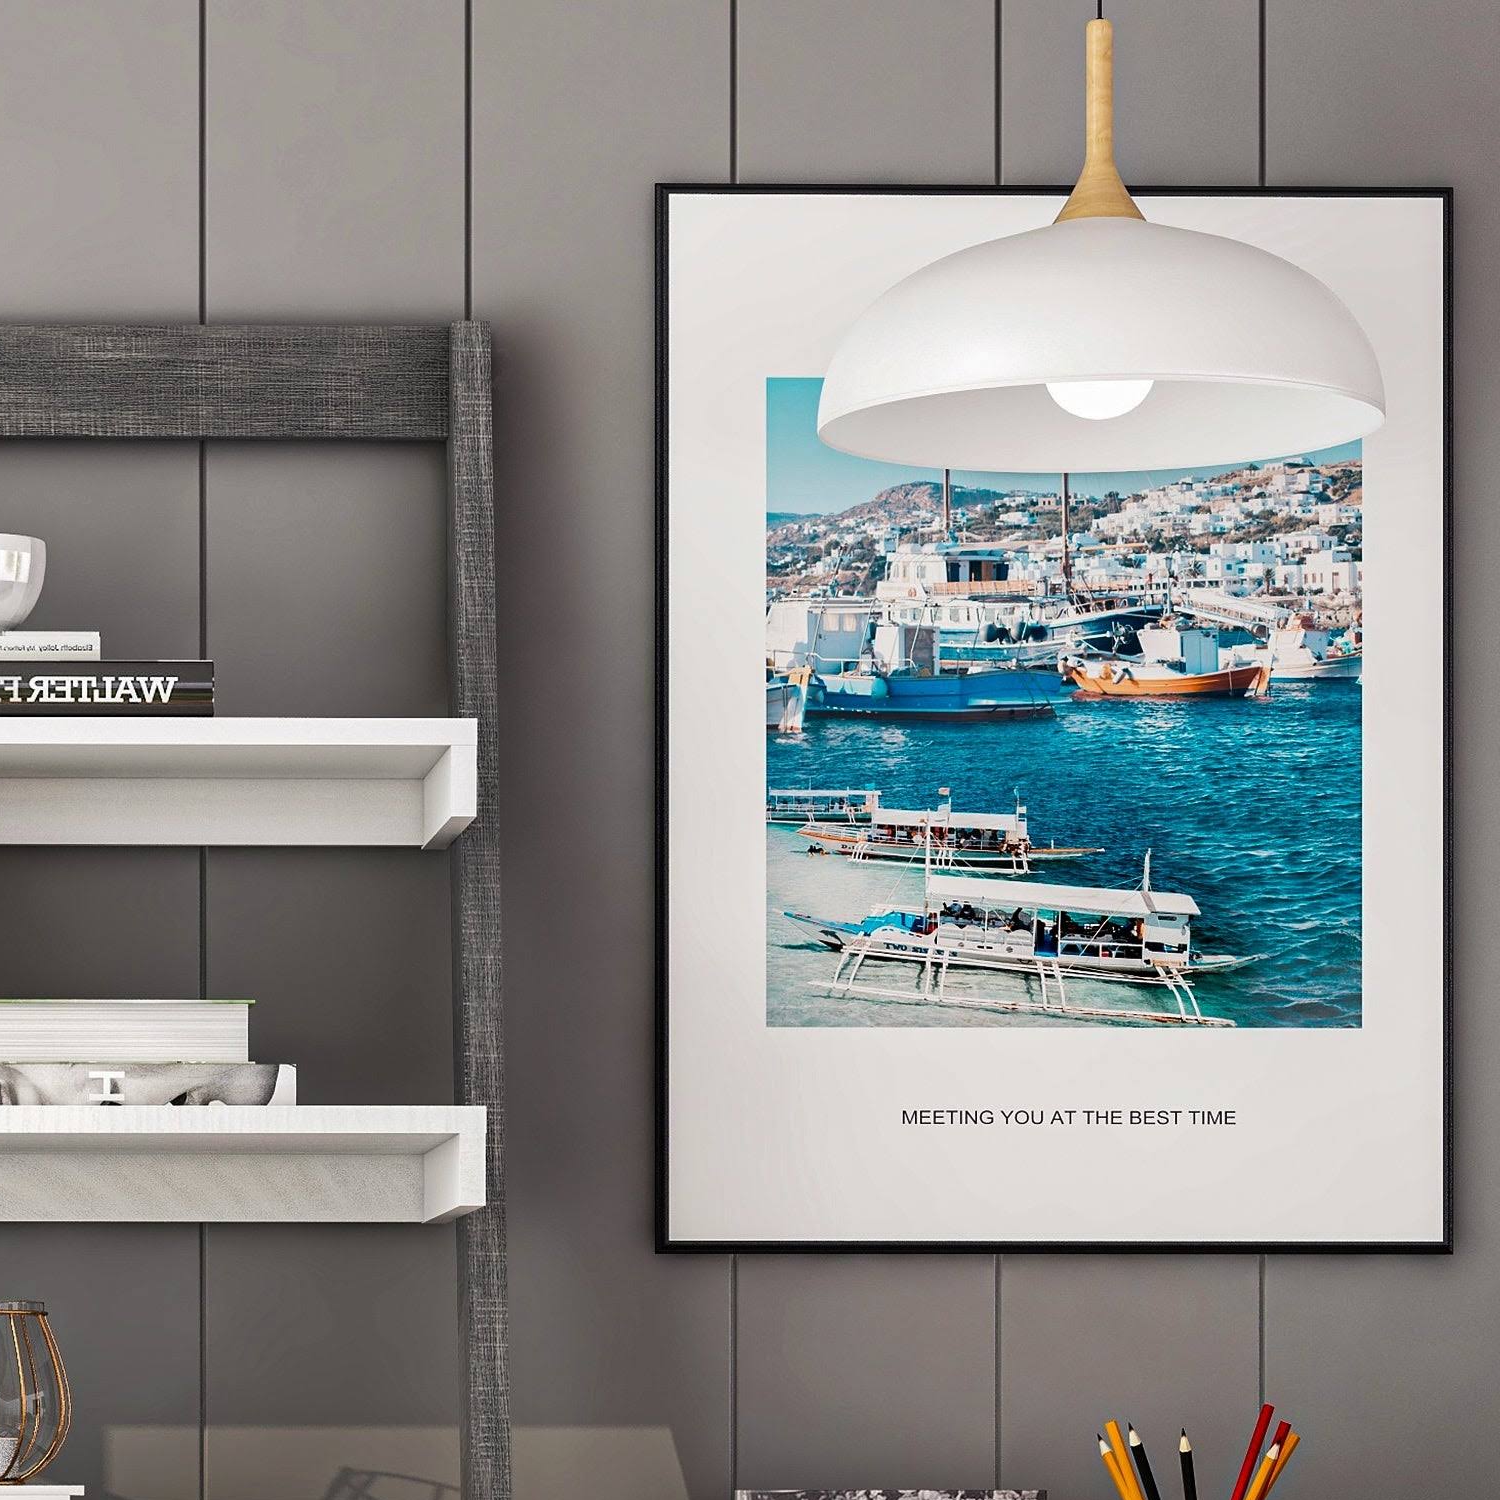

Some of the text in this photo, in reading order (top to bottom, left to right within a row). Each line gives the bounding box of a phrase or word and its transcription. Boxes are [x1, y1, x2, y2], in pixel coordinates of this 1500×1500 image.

[901, 1109, 1237, 1126] MEETING YOU AT THE BEST TIME
